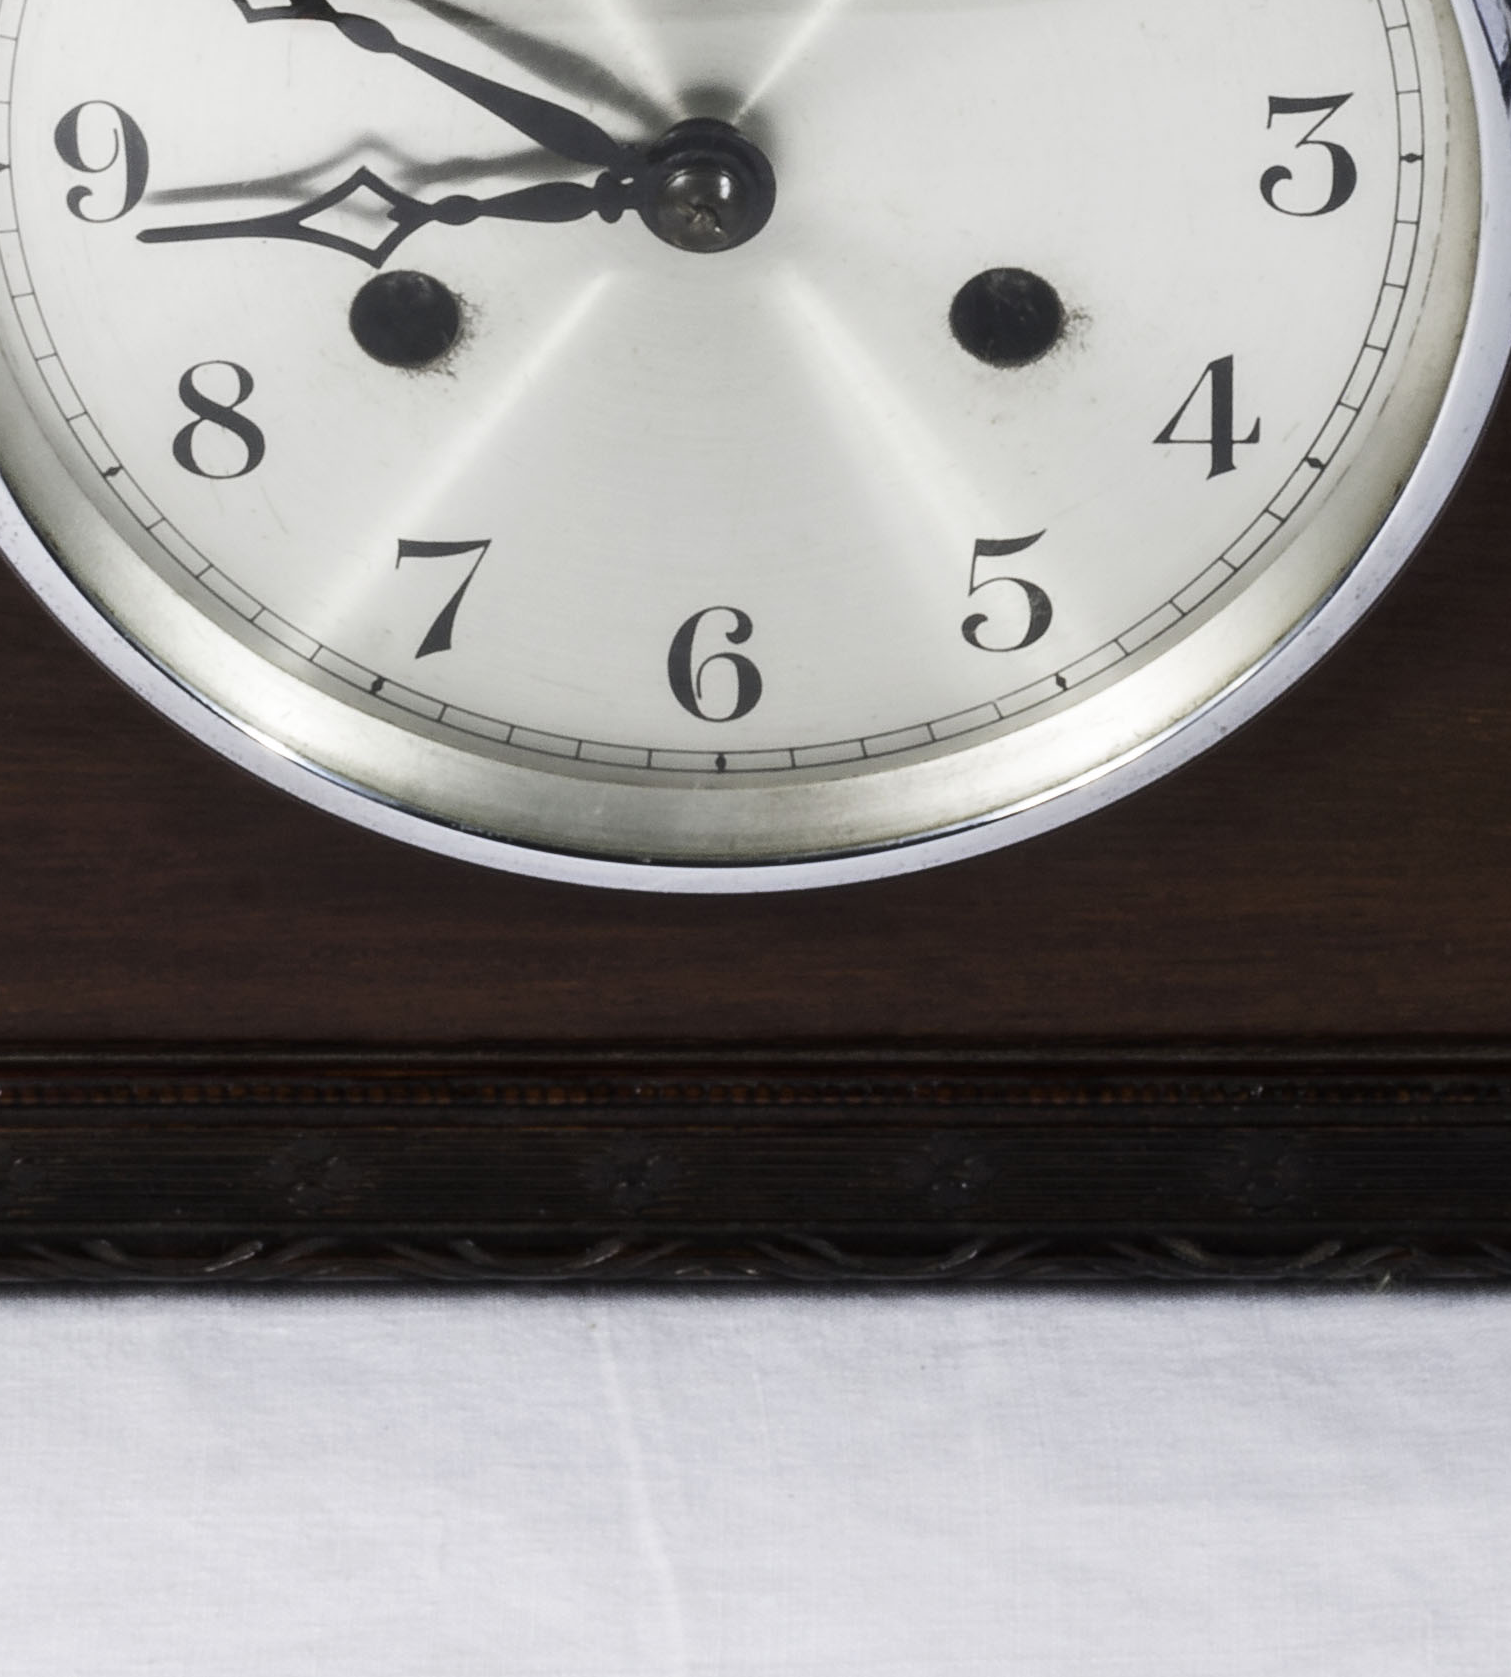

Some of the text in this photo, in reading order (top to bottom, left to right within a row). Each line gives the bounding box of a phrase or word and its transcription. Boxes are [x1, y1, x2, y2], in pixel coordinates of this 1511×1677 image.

[53, 100, 150, 223] 9
[1259, 91, 1358, 218] 3
[171, 360, 267, 480] 8
[1152, 353, 1261, 481] 4
[396, 537, 493, 660] 7
[960, 528, 1053, 654] 5
[667, 605, 764, 724] 6
